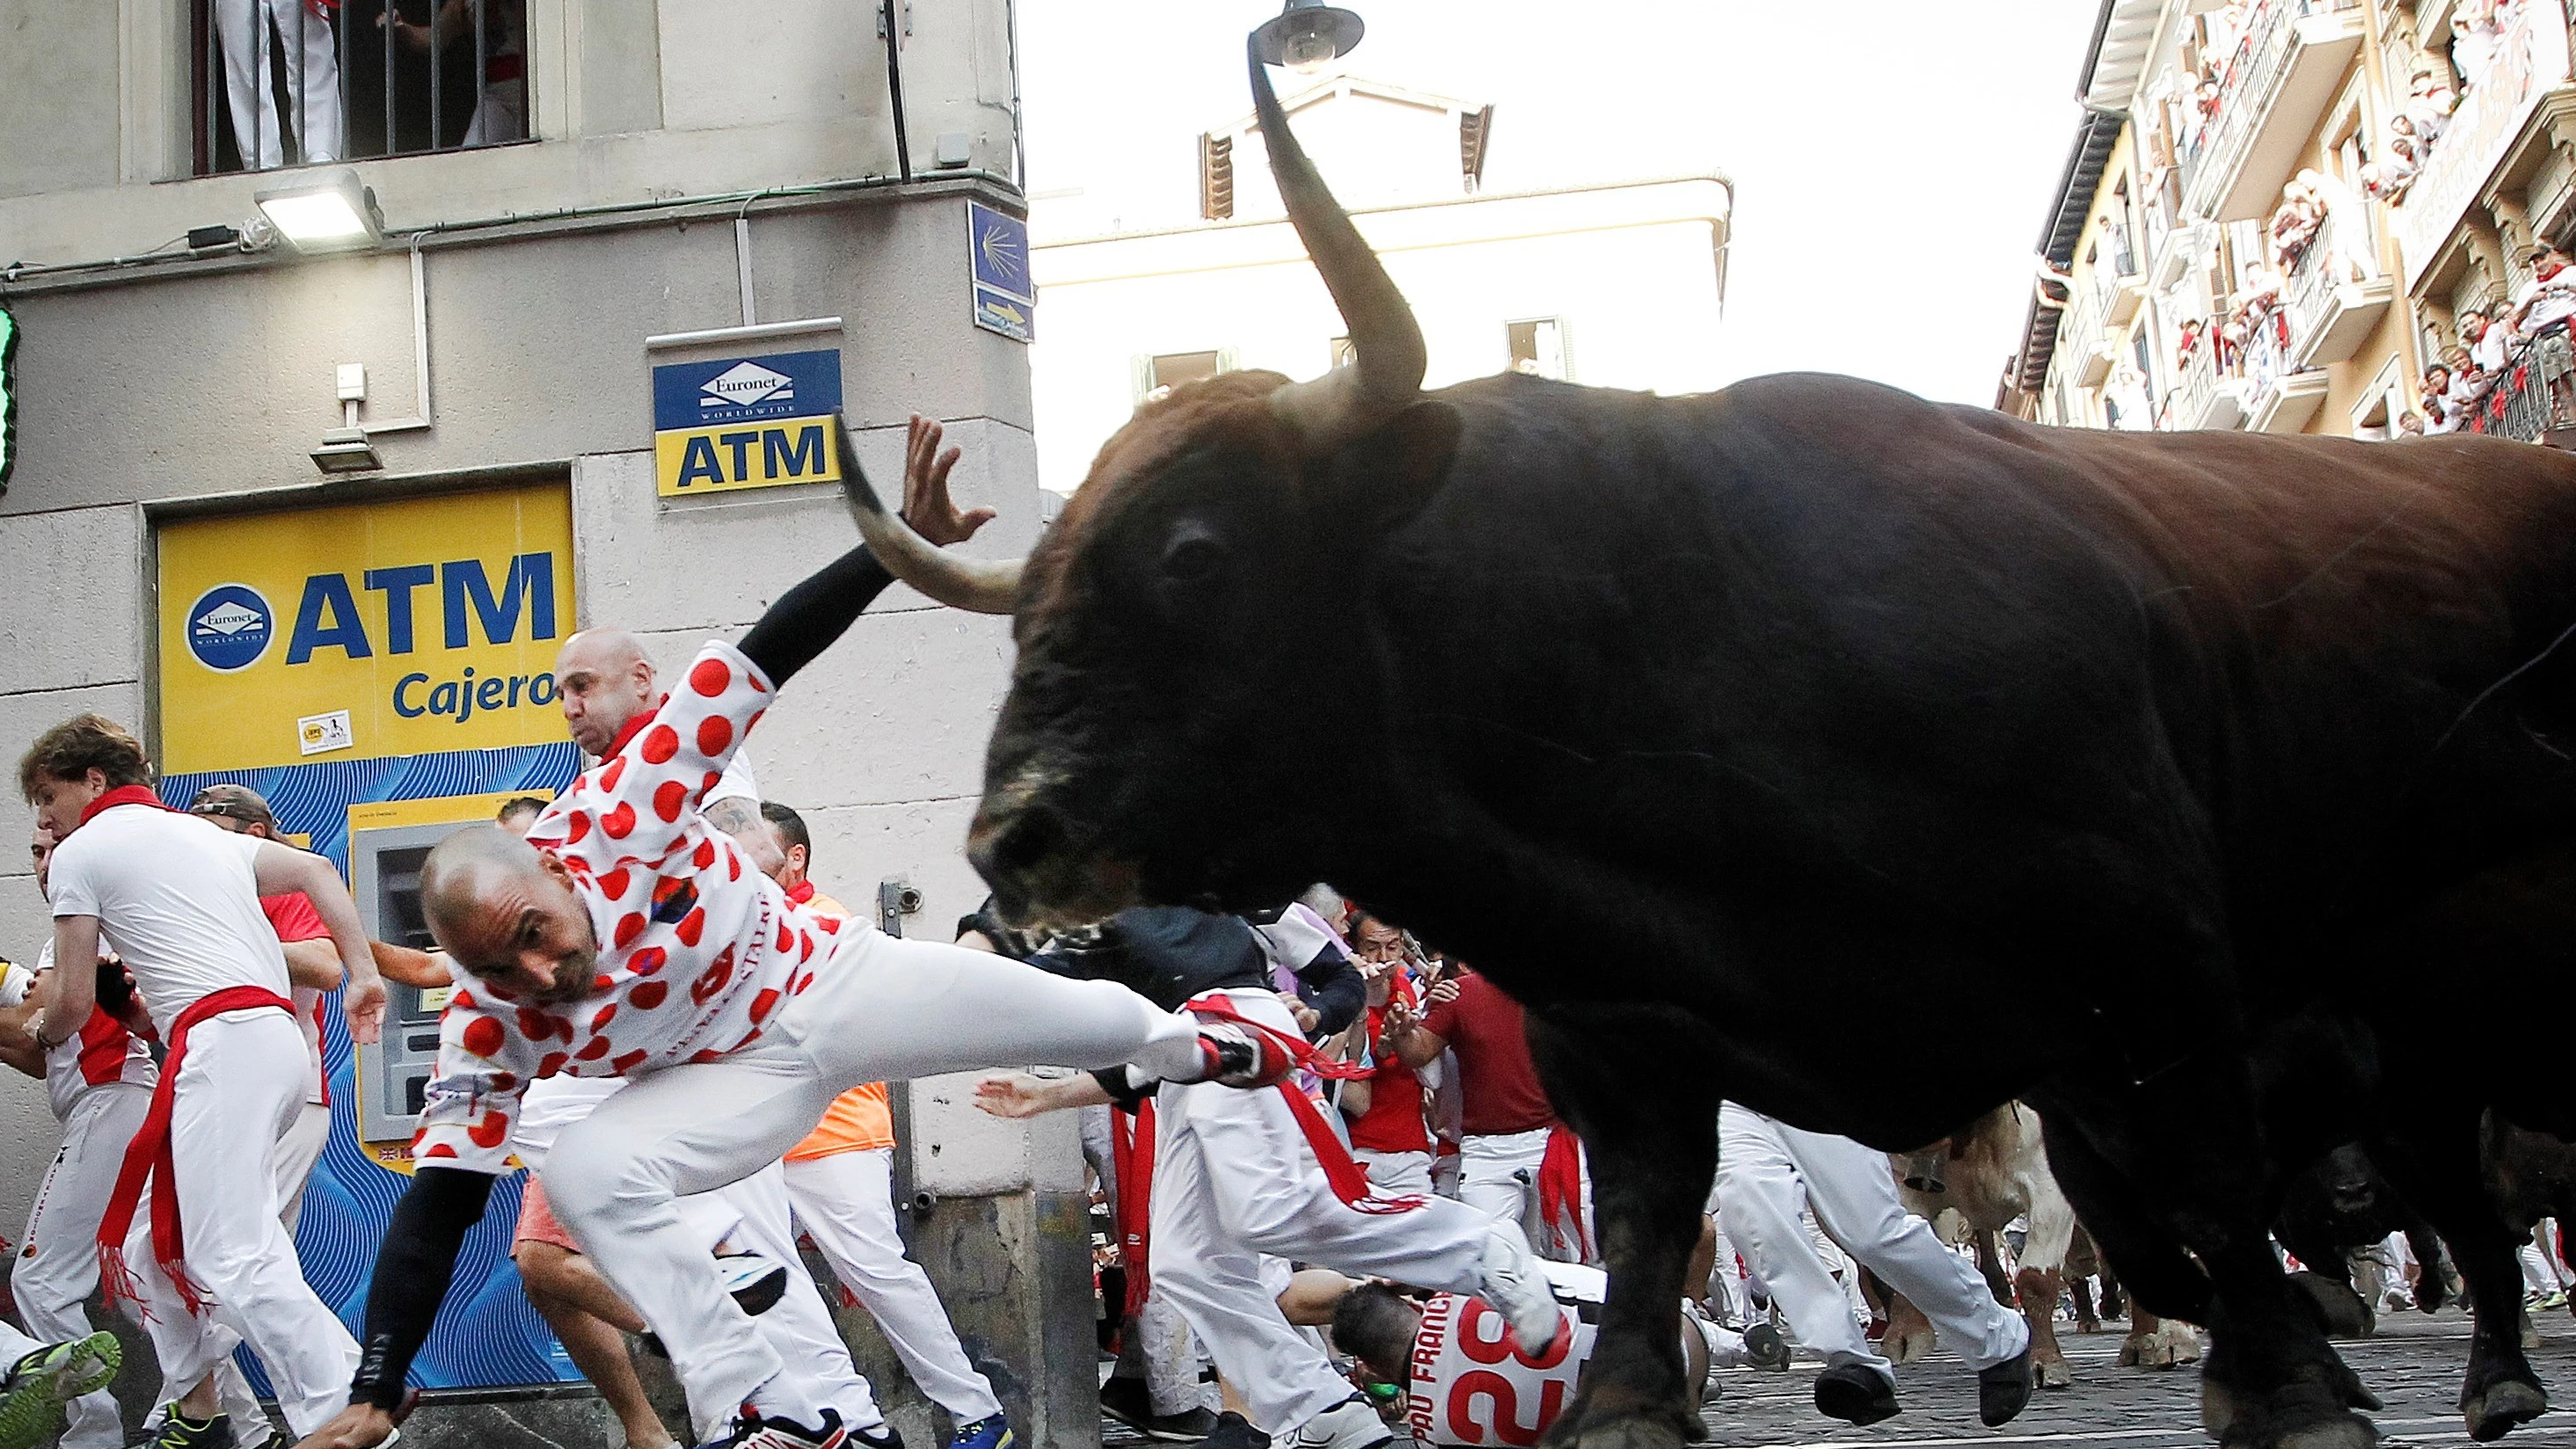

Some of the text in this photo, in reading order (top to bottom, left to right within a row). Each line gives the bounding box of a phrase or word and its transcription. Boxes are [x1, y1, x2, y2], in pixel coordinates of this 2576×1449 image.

[715, 376, 777, 393] Euronet
[700, 405, 795, 420] WORLDWIDE
[676, 425, 826, 488] ATM
[207, 614, 252, 625] Euronet
[285, 551, 557, 666] ATM
[392, 666, 556, 724] Cajero
[1448, 1296, 1572, 1447] 28
[1409, 1394, 1435, 1445] PAU
